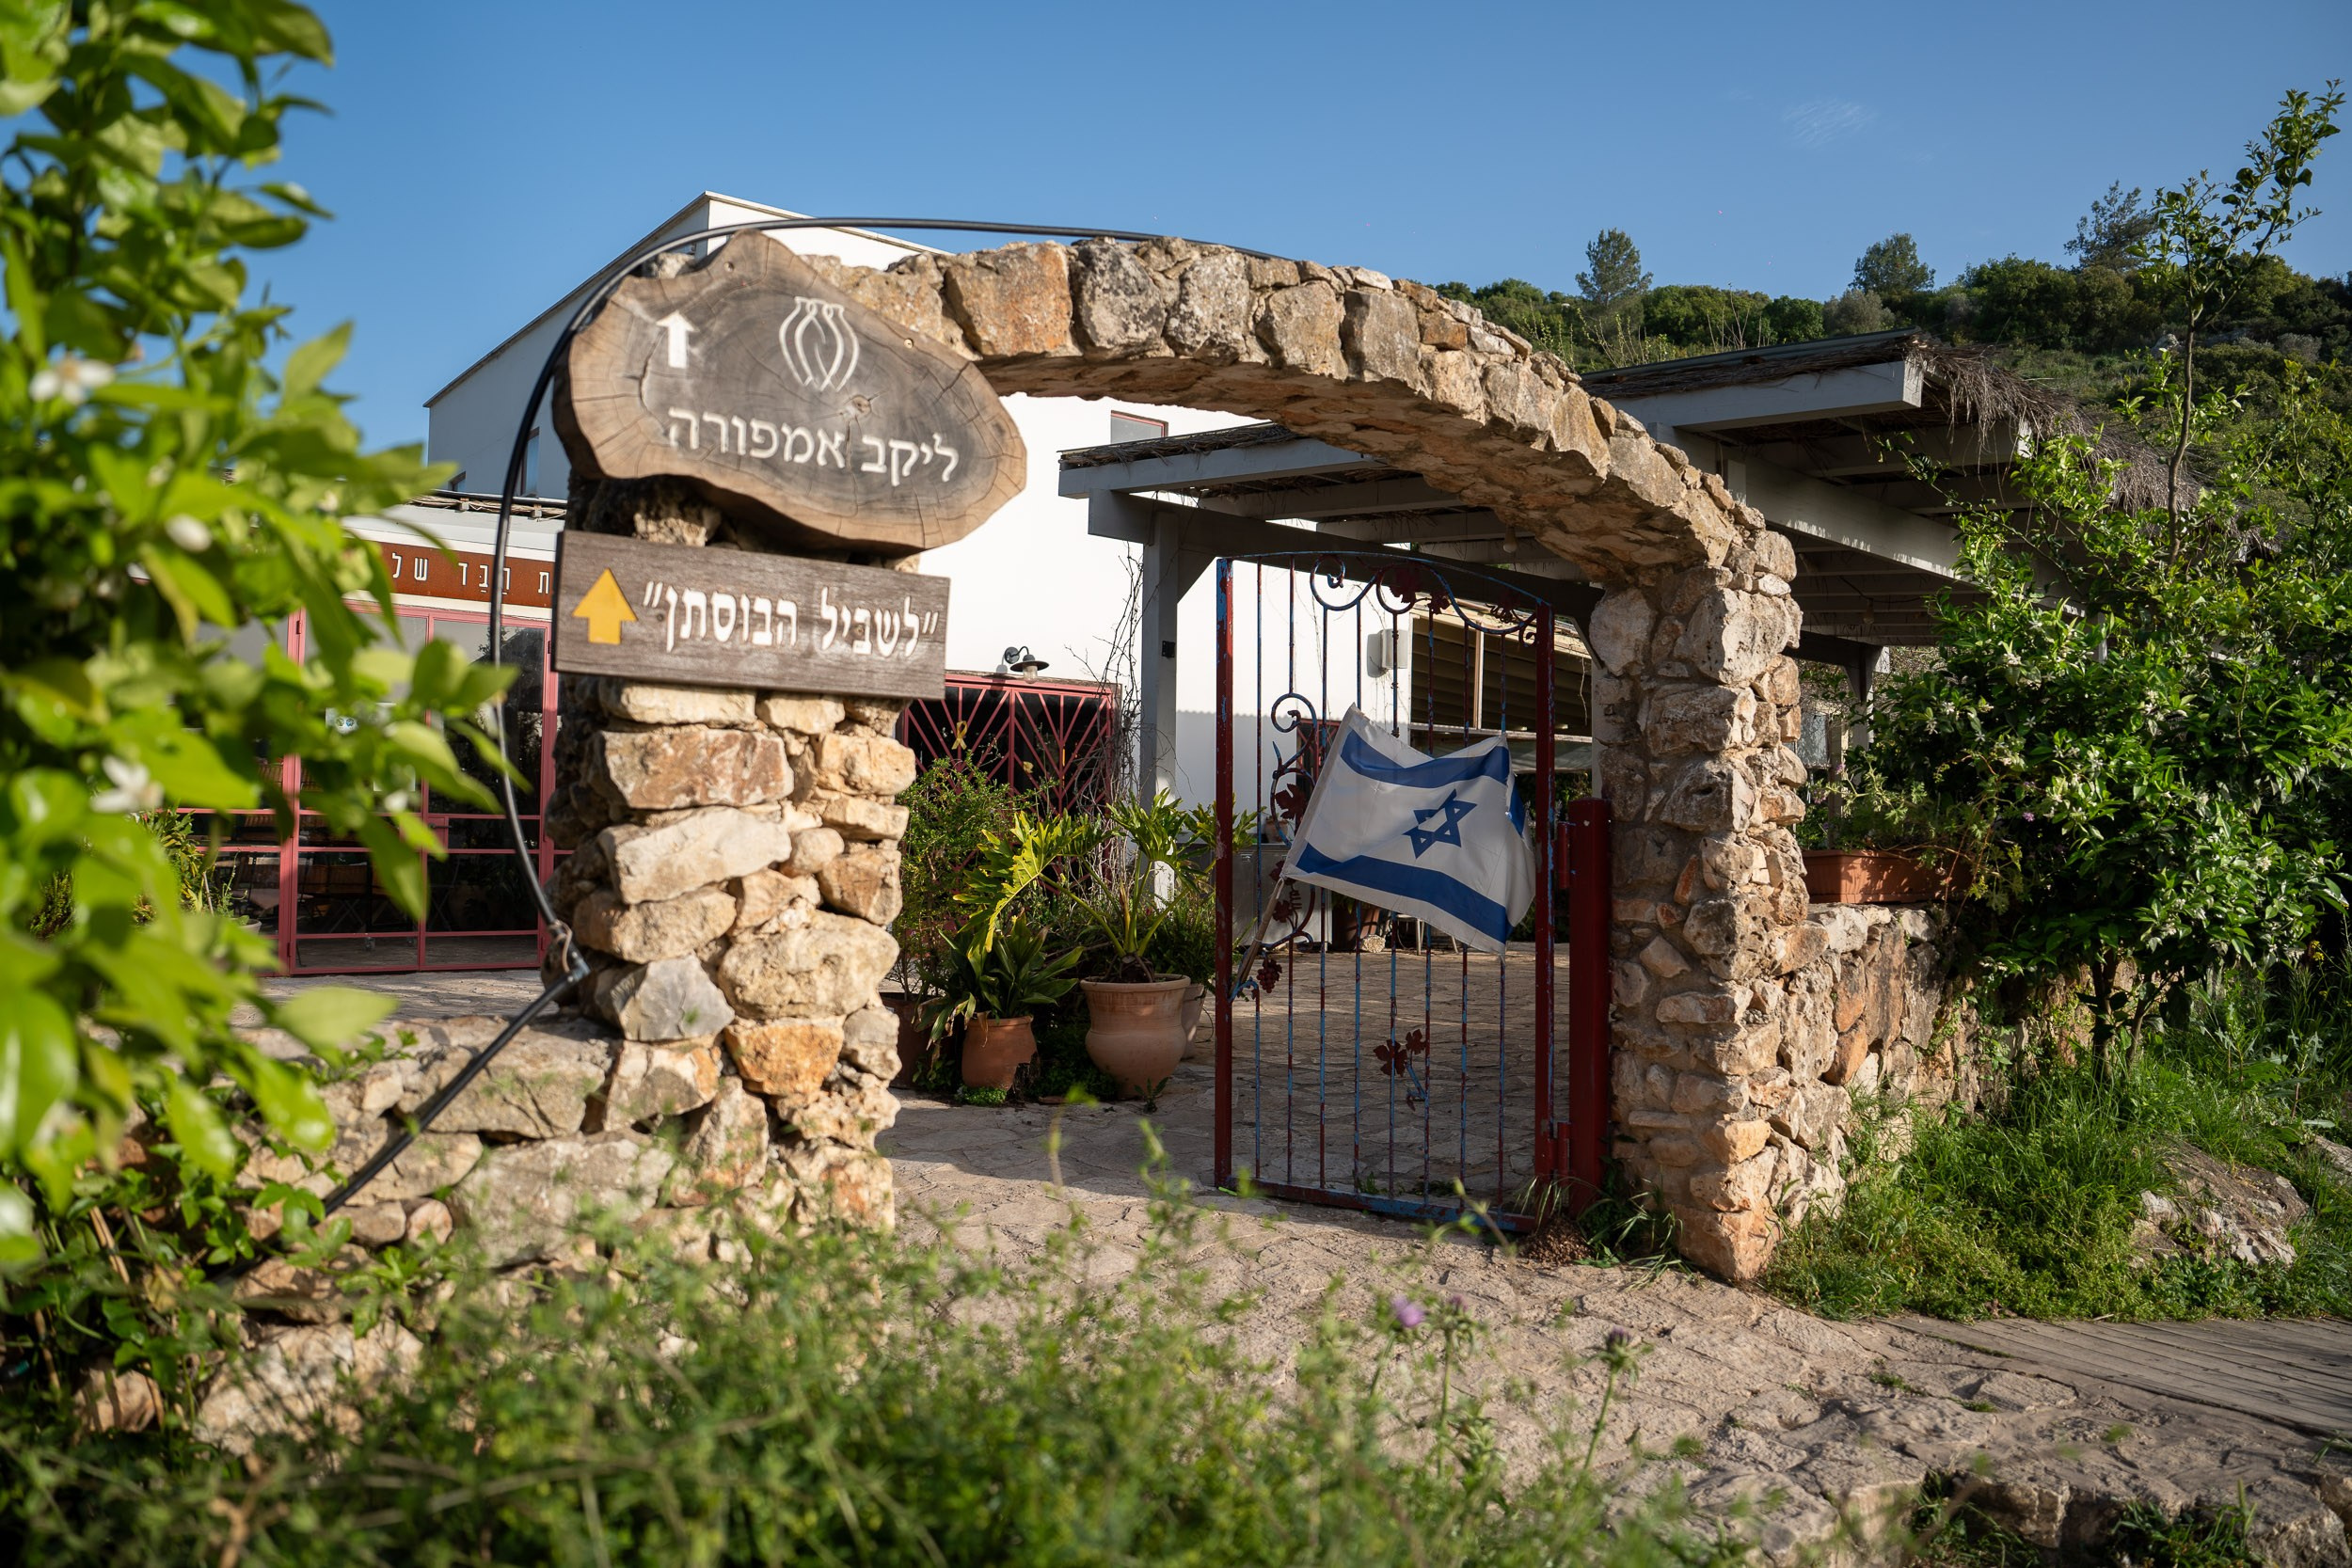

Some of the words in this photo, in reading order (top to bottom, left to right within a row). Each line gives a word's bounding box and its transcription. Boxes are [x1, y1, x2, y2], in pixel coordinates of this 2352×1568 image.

[668, 406, 846, 468] אמפורה
[860, 433, 960, 486] ליקב
[391, 552, 428, 581] של
[820, 586, 939, 657] "לשביל
